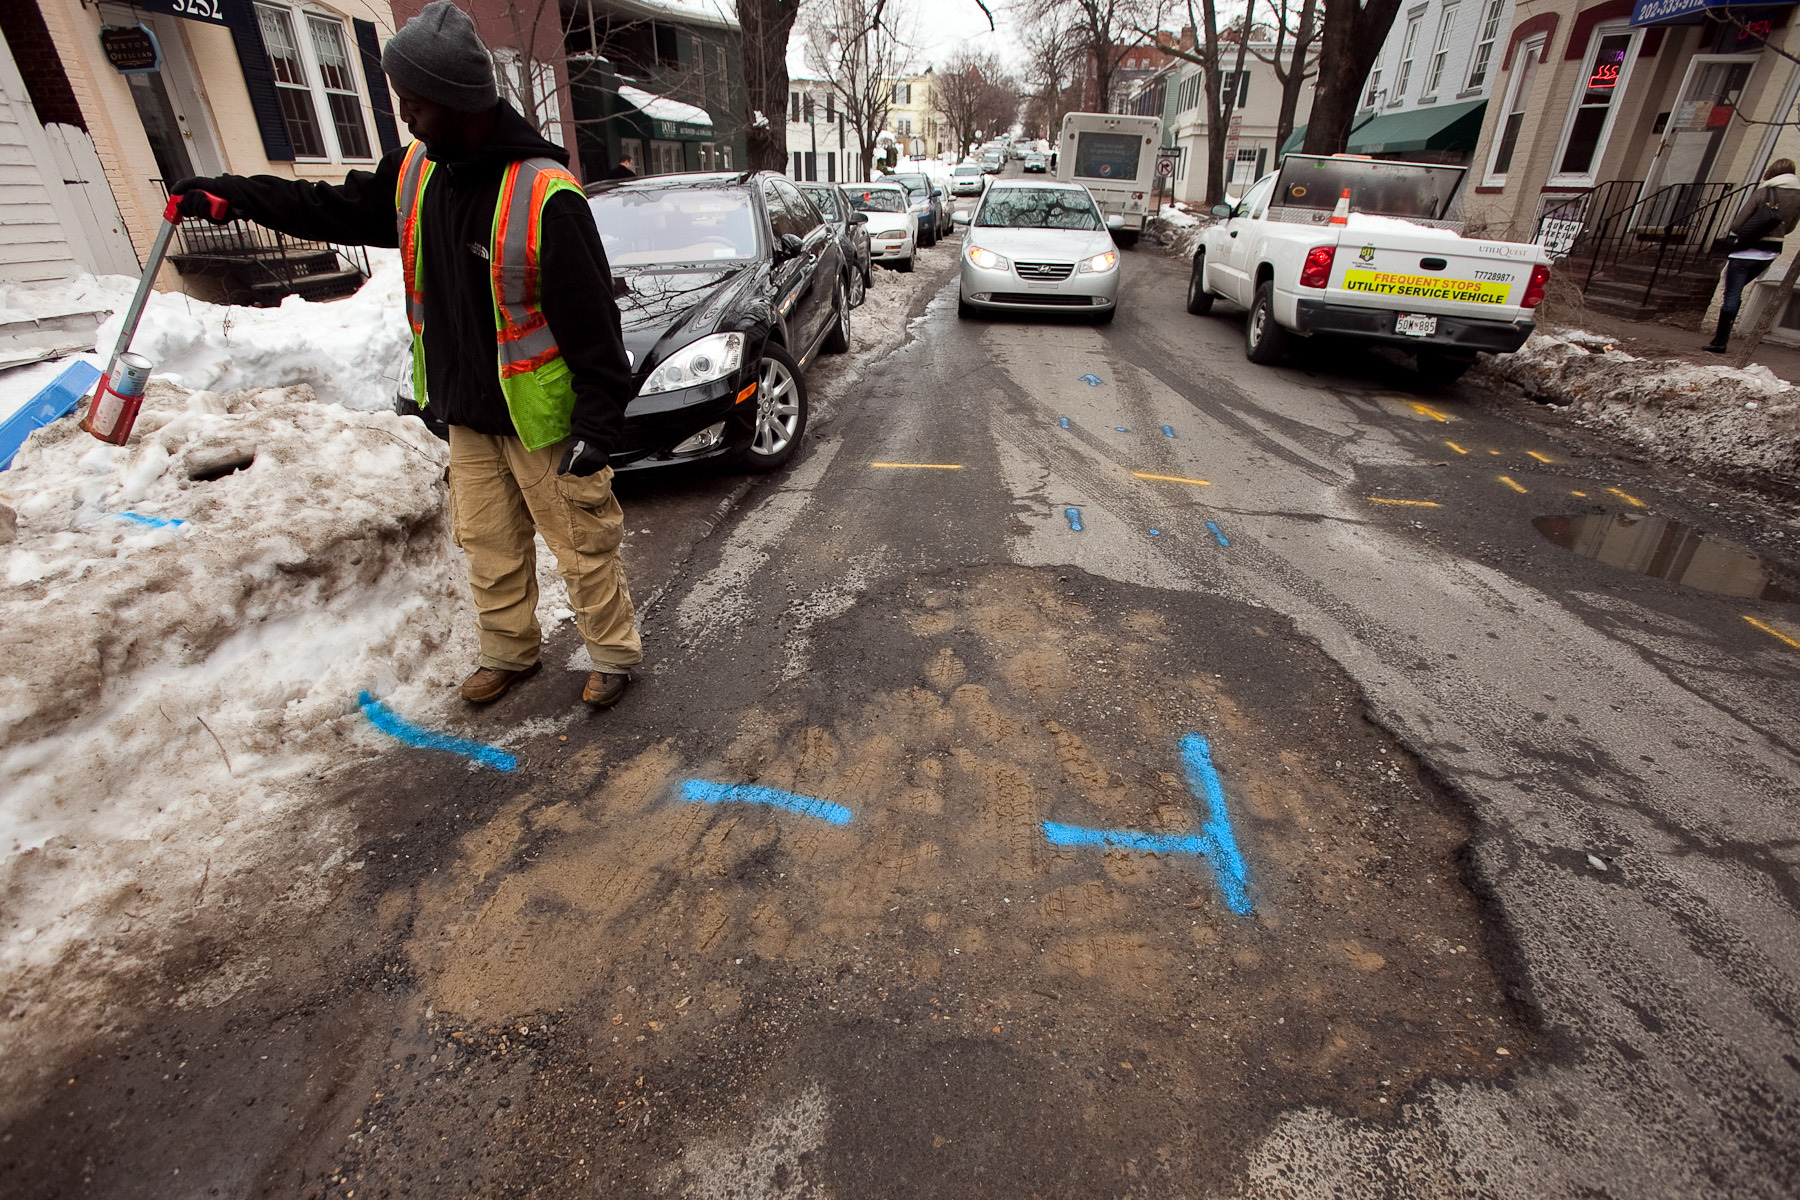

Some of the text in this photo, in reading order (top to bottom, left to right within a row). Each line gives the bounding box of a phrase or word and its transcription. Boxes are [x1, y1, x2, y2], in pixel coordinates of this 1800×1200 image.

[106, 40, 149, 50] BURTON
[109, 51, 153, 60] OPTICIAN
[1474, 270, 1511, 282] T7728987
[1373, 273, 1482, 292] FREQUENT STOPS
[1347, 280, 1505, 304] UTILITY SERVICE VEHICLE
